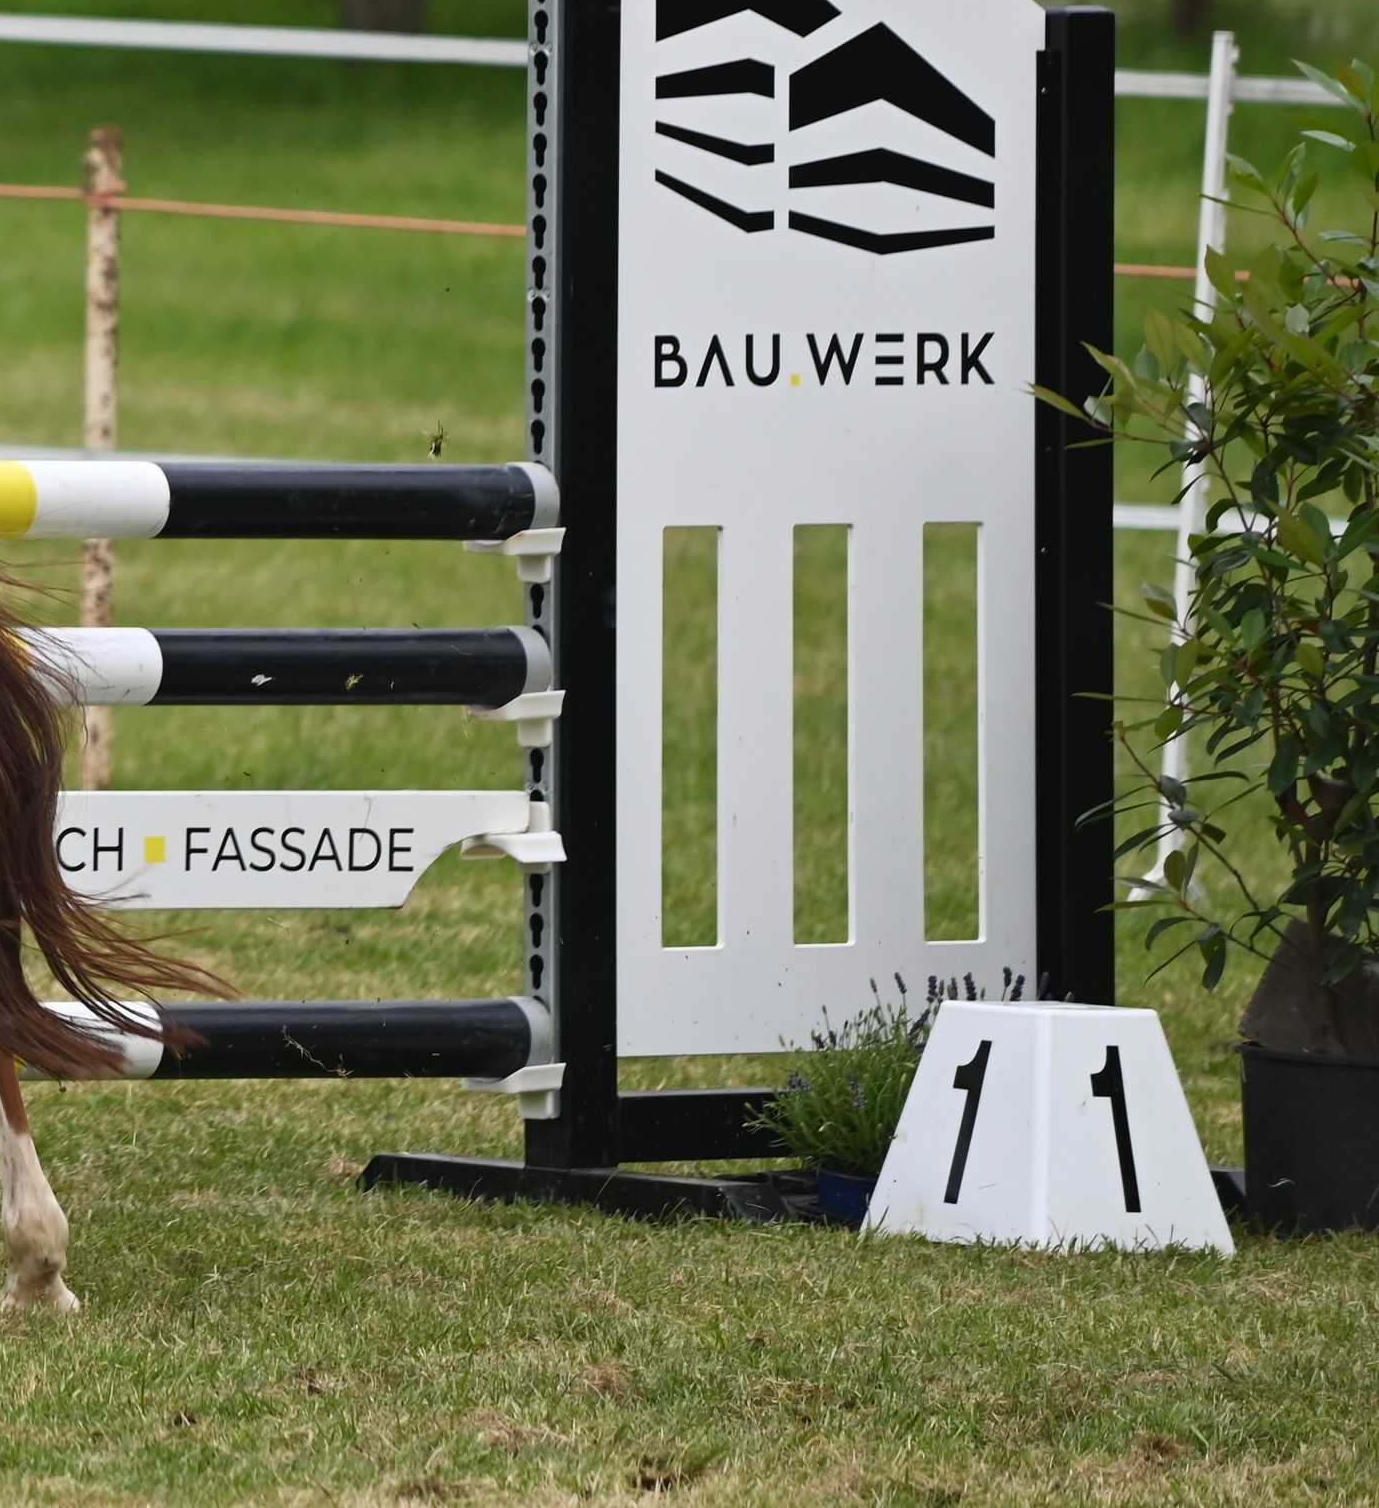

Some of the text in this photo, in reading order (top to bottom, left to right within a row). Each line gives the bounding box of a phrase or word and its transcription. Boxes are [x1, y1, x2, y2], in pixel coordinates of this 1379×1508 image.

[654, 332, 995, 387] BAU.WERK
[55, 827, 125, 873] CH
[184, 827, 415, 872] FASSADE
[943, 1039, 993, 1205] 1
[1089, 1044, 1142, 1213] 1
